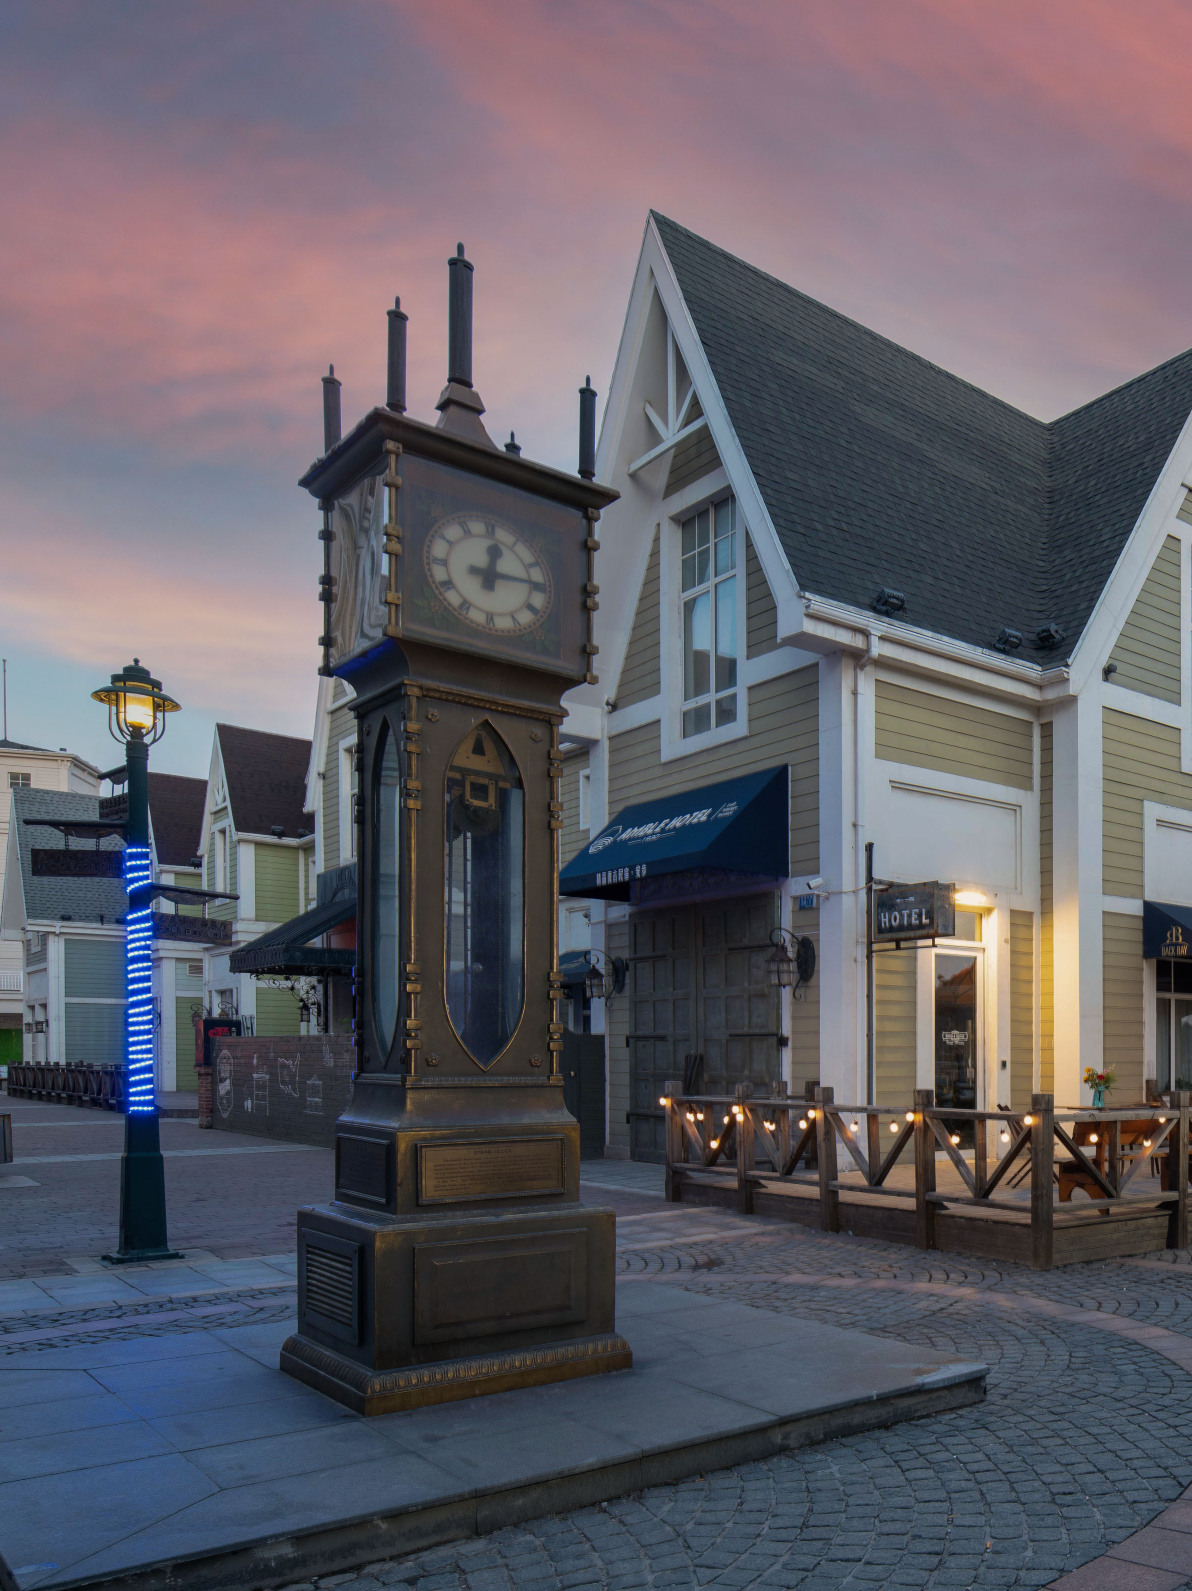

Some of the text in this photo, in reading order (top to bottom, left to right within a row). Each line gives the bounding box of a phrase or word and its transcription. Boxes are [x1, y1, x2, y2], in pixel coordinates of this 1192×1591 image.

[616, 818, 670, 843] AMBLE
[665, 808, 713, 831] HOTEL
[881, 908, 930, 929] HOTEL
[1161, 944, 1188, 957] BACK BAY
